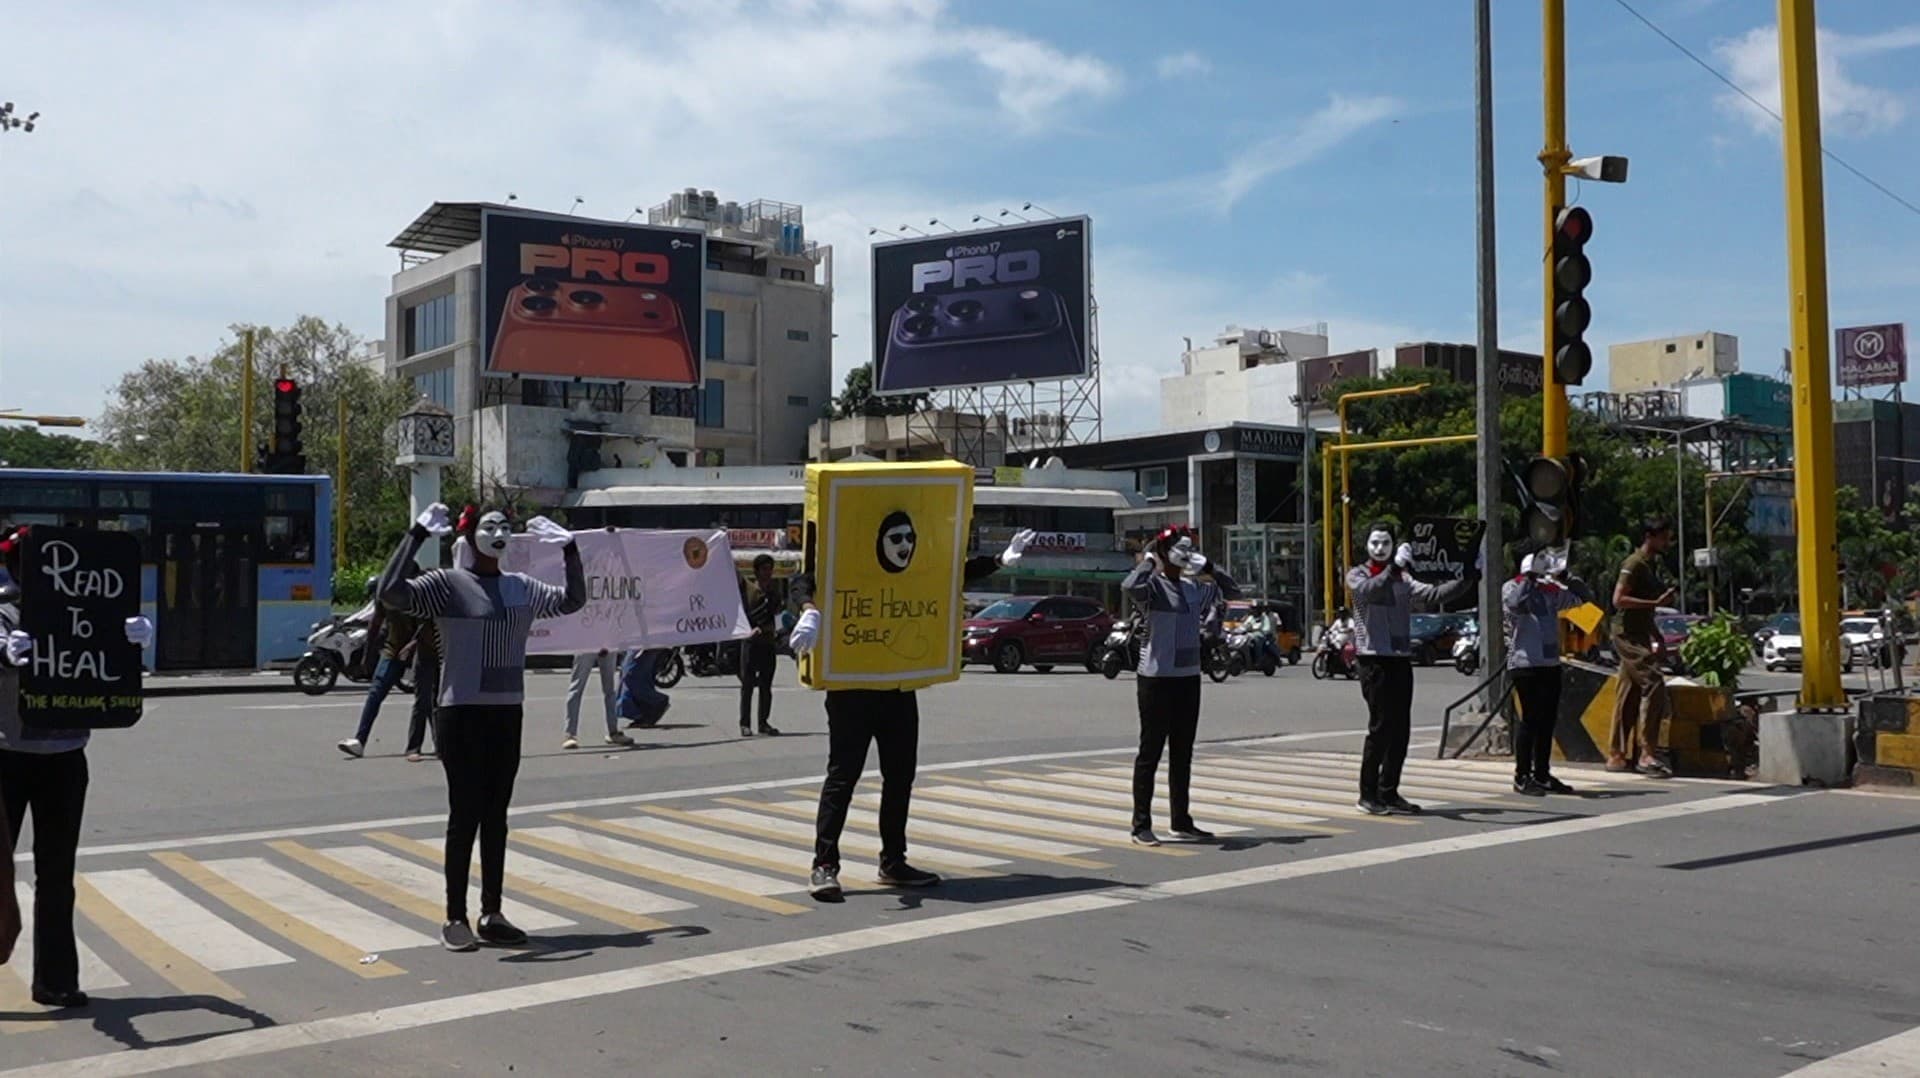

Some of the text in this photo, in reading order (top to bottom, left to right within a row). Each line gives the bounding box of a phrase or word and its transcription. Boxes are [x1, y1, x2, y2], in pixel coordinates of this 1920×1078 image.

[571, 233, 625, 249] iPhone 17
[953, 241, 1000, 258] iPhone 17
[520, 243, 669, 285] PRO
[912, 250, 1040, 293] PRO
[41, 540, 123, 598] READ
[688, 594, 705, 611] PR
[836, 588, 873, 619] THE
[842, 623, 890, 646] SHELF
[33, 633, 121, 681] HEAL
